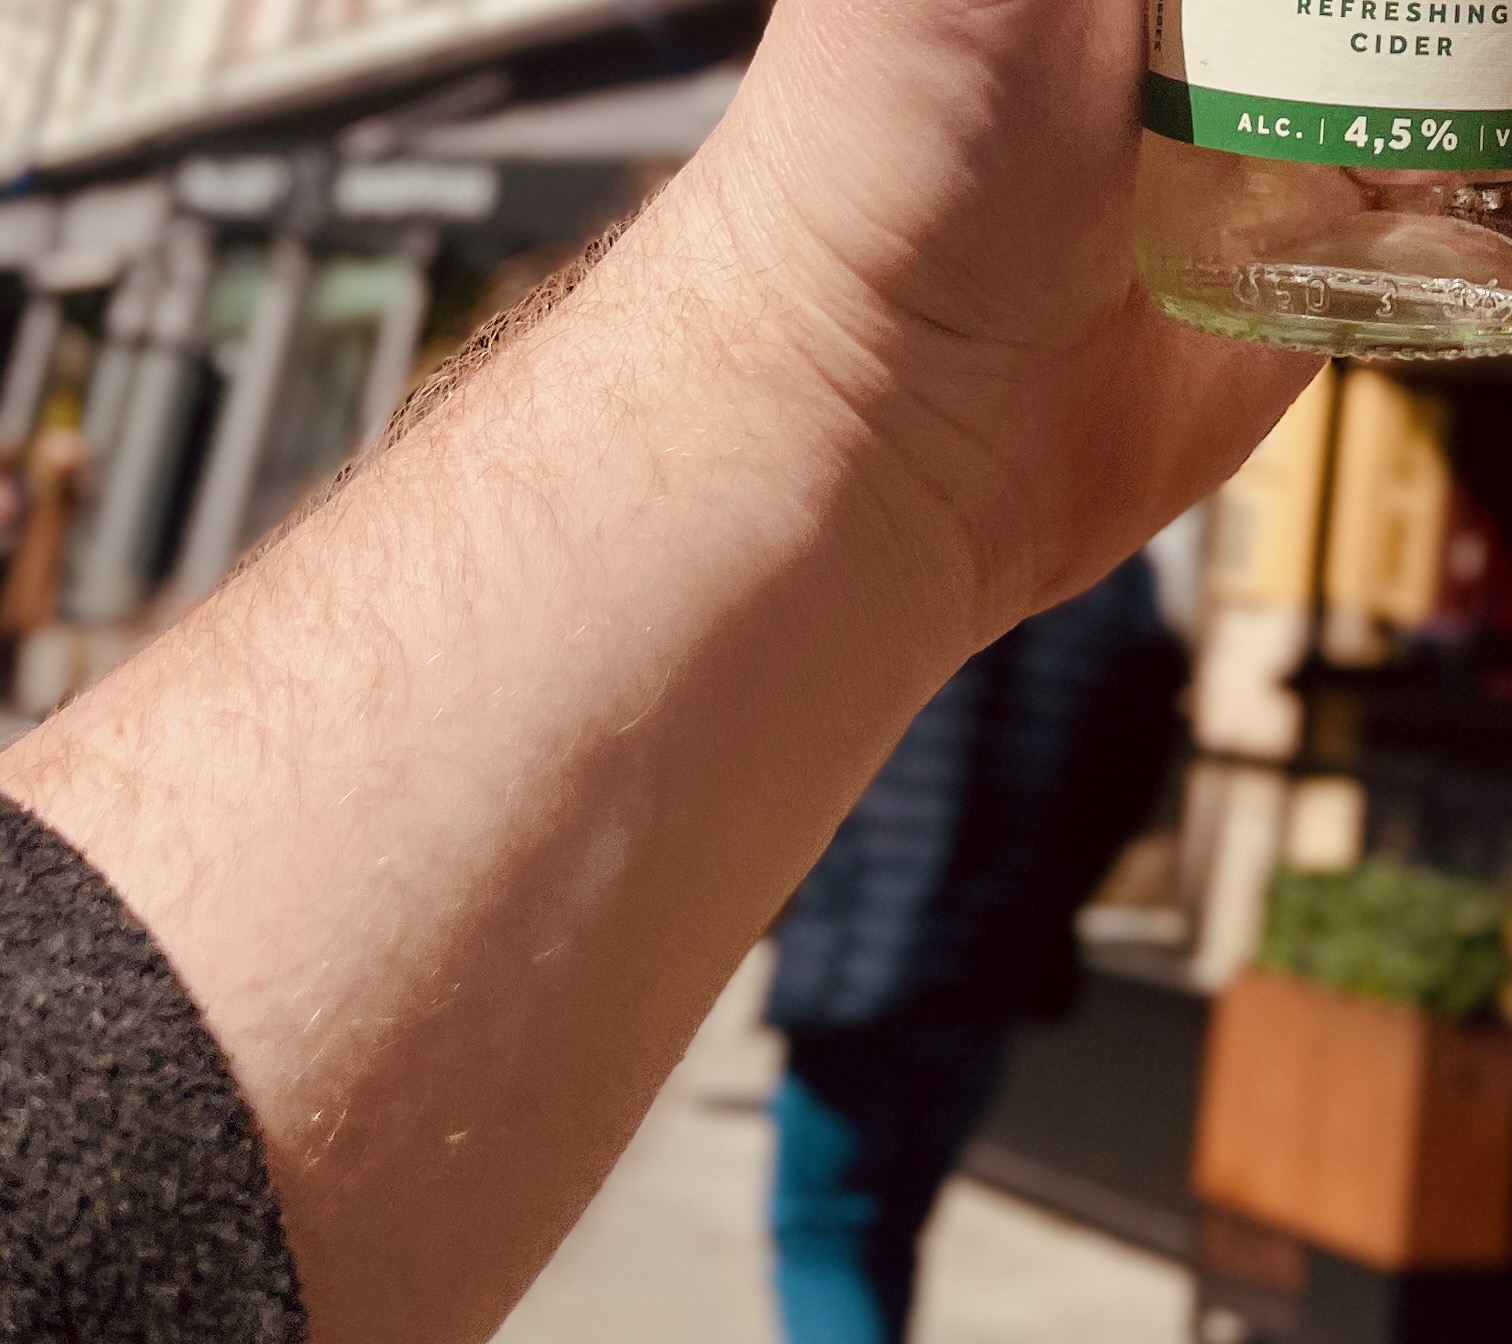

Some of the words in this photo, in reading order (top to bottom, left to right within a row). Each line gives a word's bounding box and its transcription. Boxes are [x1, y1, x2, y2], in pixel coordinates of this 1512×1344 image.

[1350, 31, 1454, 57] CIDER
[1236, 111, 1303, 140] ALC.
[1343, 114, 1459, 156] 4,5%
